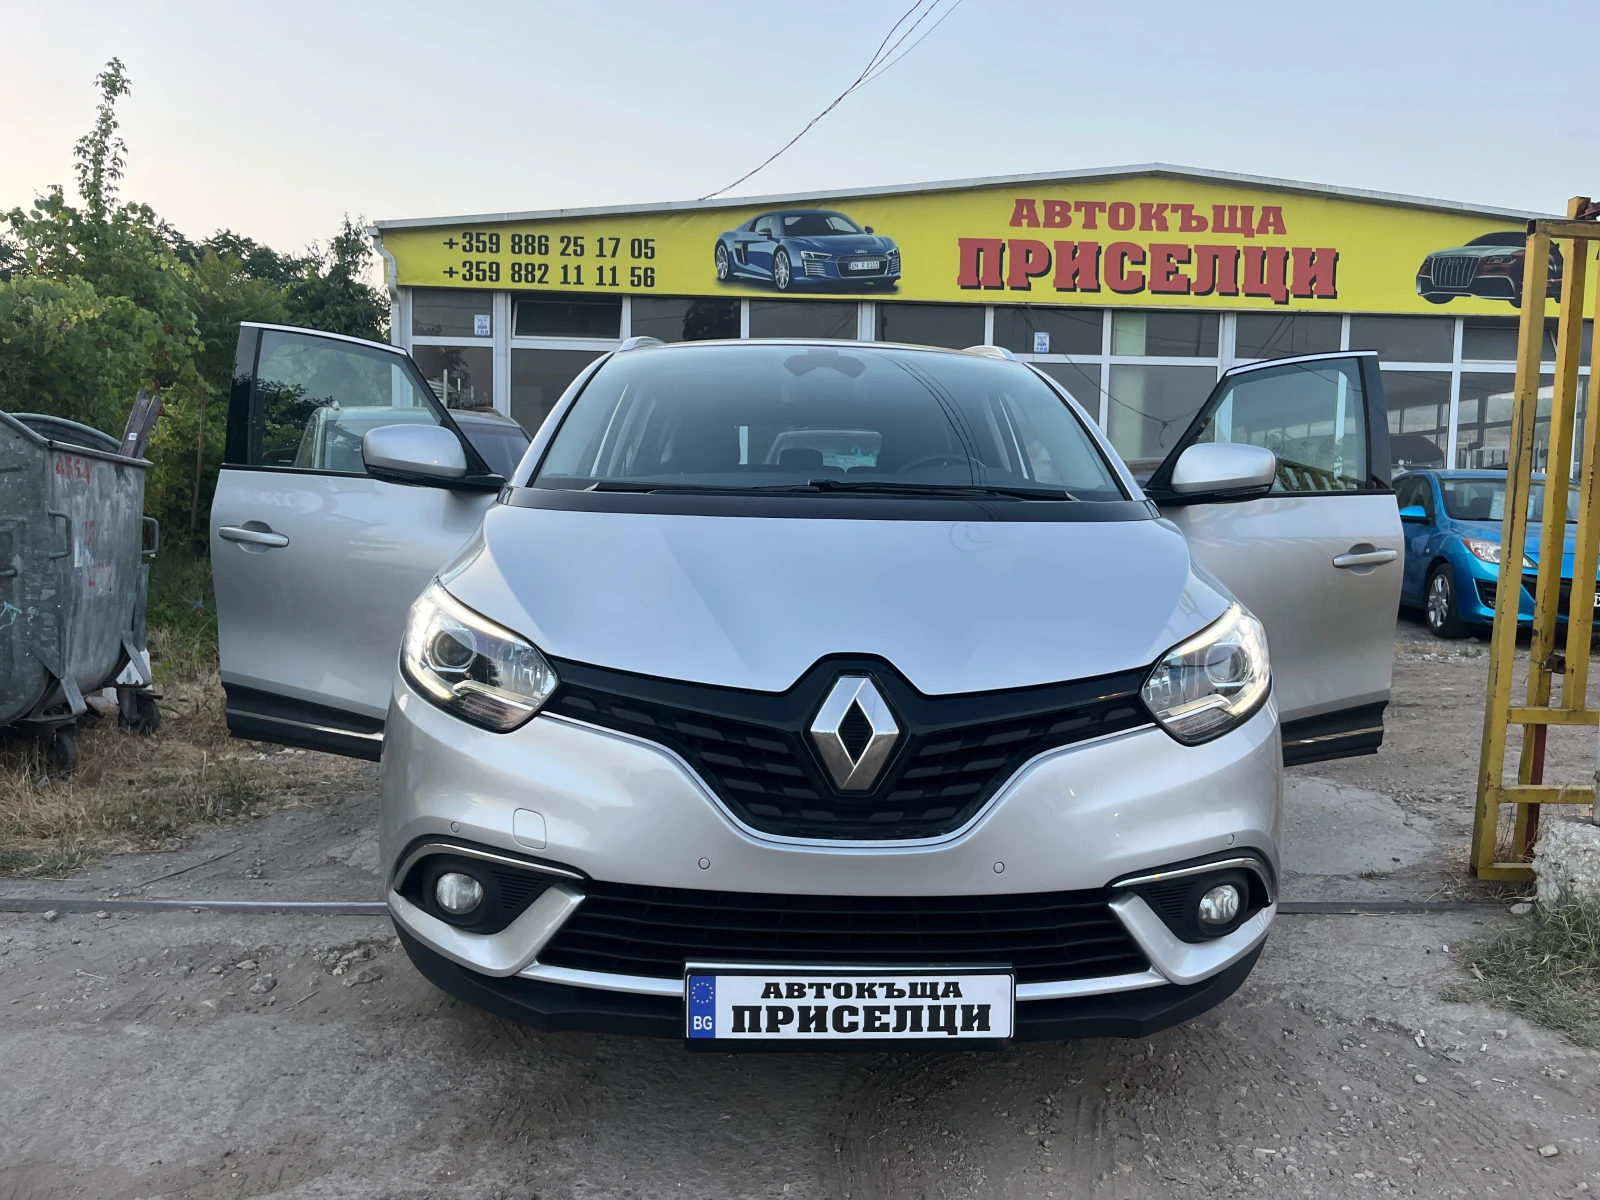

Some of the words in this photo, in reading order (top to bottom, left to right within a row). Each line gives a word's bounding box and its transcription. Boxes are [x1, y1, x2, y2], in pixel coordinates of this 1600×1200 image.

[1009, 198, 1287, 238] АВТОКЪЩА
[443, 232, 501, 254] +359
[511, 233, 550, 256] 886
[560, 236, 585, 257] 25
[595, 237, 621, 258] 17
[630, 238, 656, 260] 05
[443, 260, 501, 282] +359
[511, 262, 550, 284] 882
[559, 264, 585, 286] 11
[595, 265, 620, 287] 11
[630, 266, 656, 288] 56
[957, 238, 1340, 305] ПРИСЕЛЦИ
[761, 981, 963, 1000] АВТОКЪЩА
[693, 1015, 713, 1031] BG
[731, 1003, 992, 1036] ПРИСЕЛЦИ
